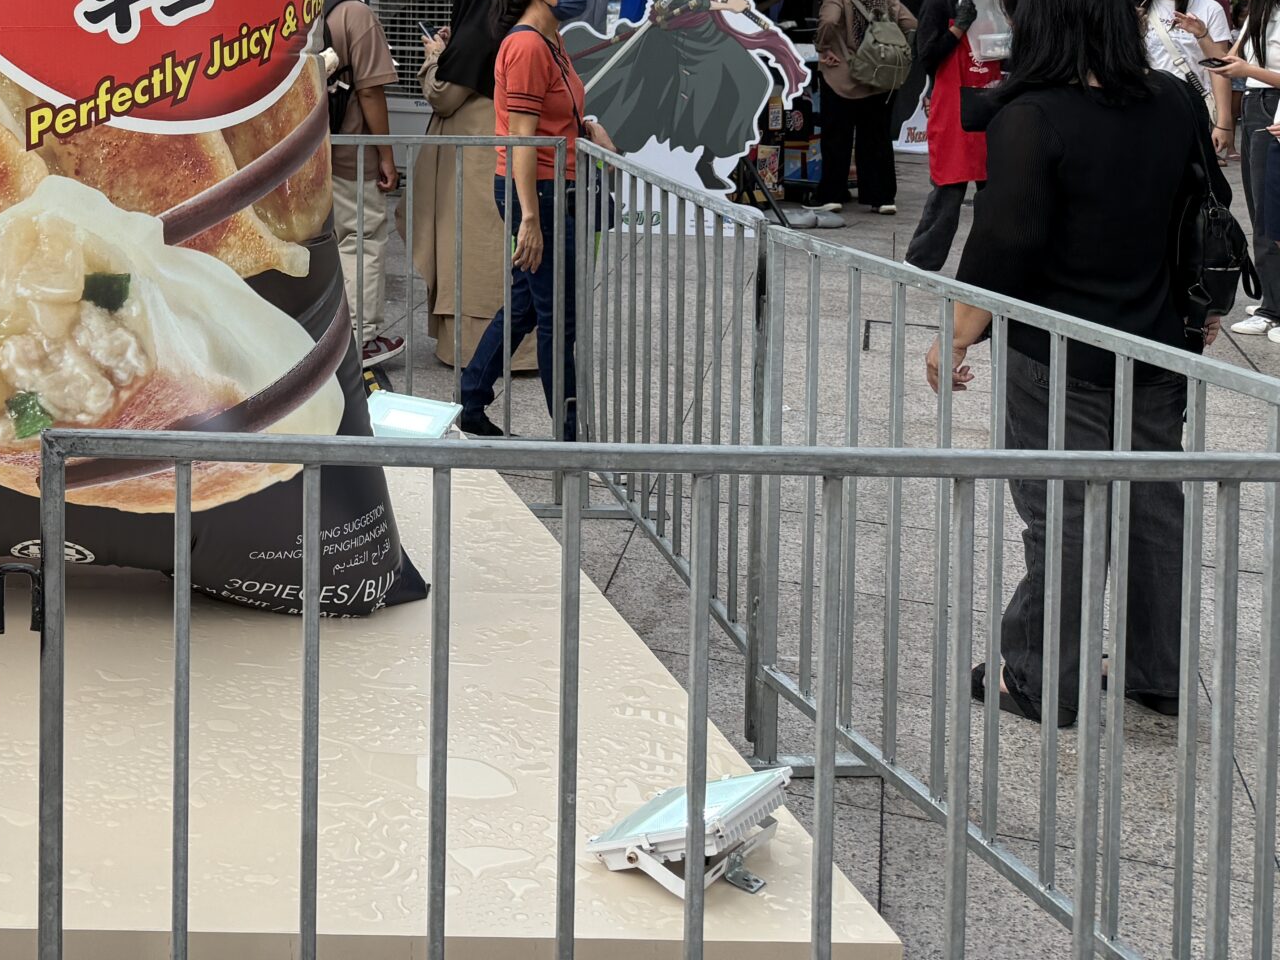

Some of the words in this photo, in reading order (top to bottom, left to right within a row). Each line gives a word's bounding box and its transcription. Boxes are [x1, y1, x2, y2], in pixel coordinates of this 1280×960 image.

[29, 55, 197, 146] Perfectly
[206, 22, 277, 76] Juicy
[281, 4, 298, 38] &
[343, 503, 385, 535] SUGGESTION
[248, 549, 303, 560] CADANG
[322, 520, 389, 557] PENGHIDANGAN
